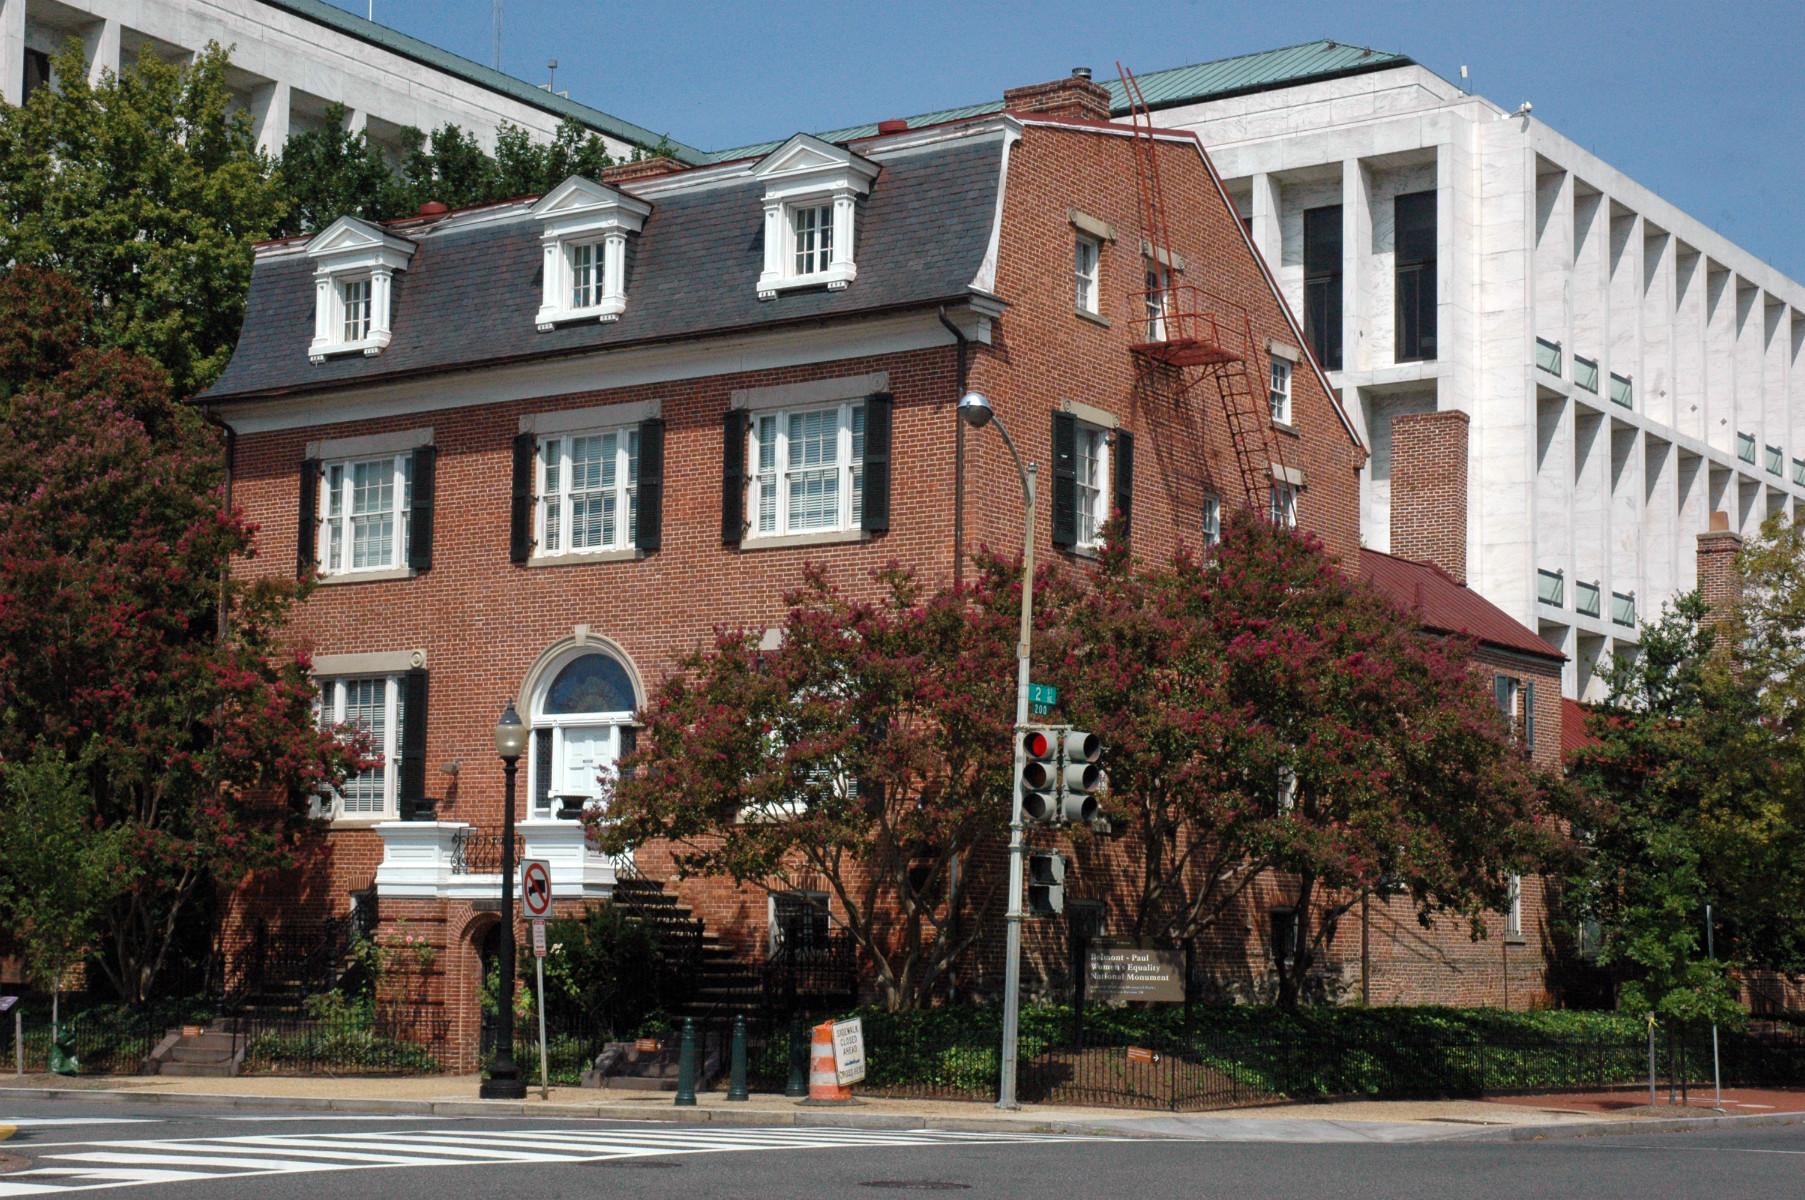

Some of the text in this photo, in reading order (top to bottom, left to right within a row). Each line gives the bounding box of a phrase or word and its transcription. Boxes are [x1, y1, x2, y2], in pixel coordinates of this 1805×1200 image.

[1035, 686, 1042, 701] 2
[1034, 703, 1047, 715] 200
[1090, 953, 1124, 961] Belmont
[1131, 953, 1149, 962] Paul
[1090, 962, 1161, 973] Women's Equality
[1090, 972, 1169, 981] National Monument
[836, 1024, 859, 1037] SIDEWALK
[840, 1034, 858, 1047] CLOSED
[843, 1045, 858, 1056] AHEAD
